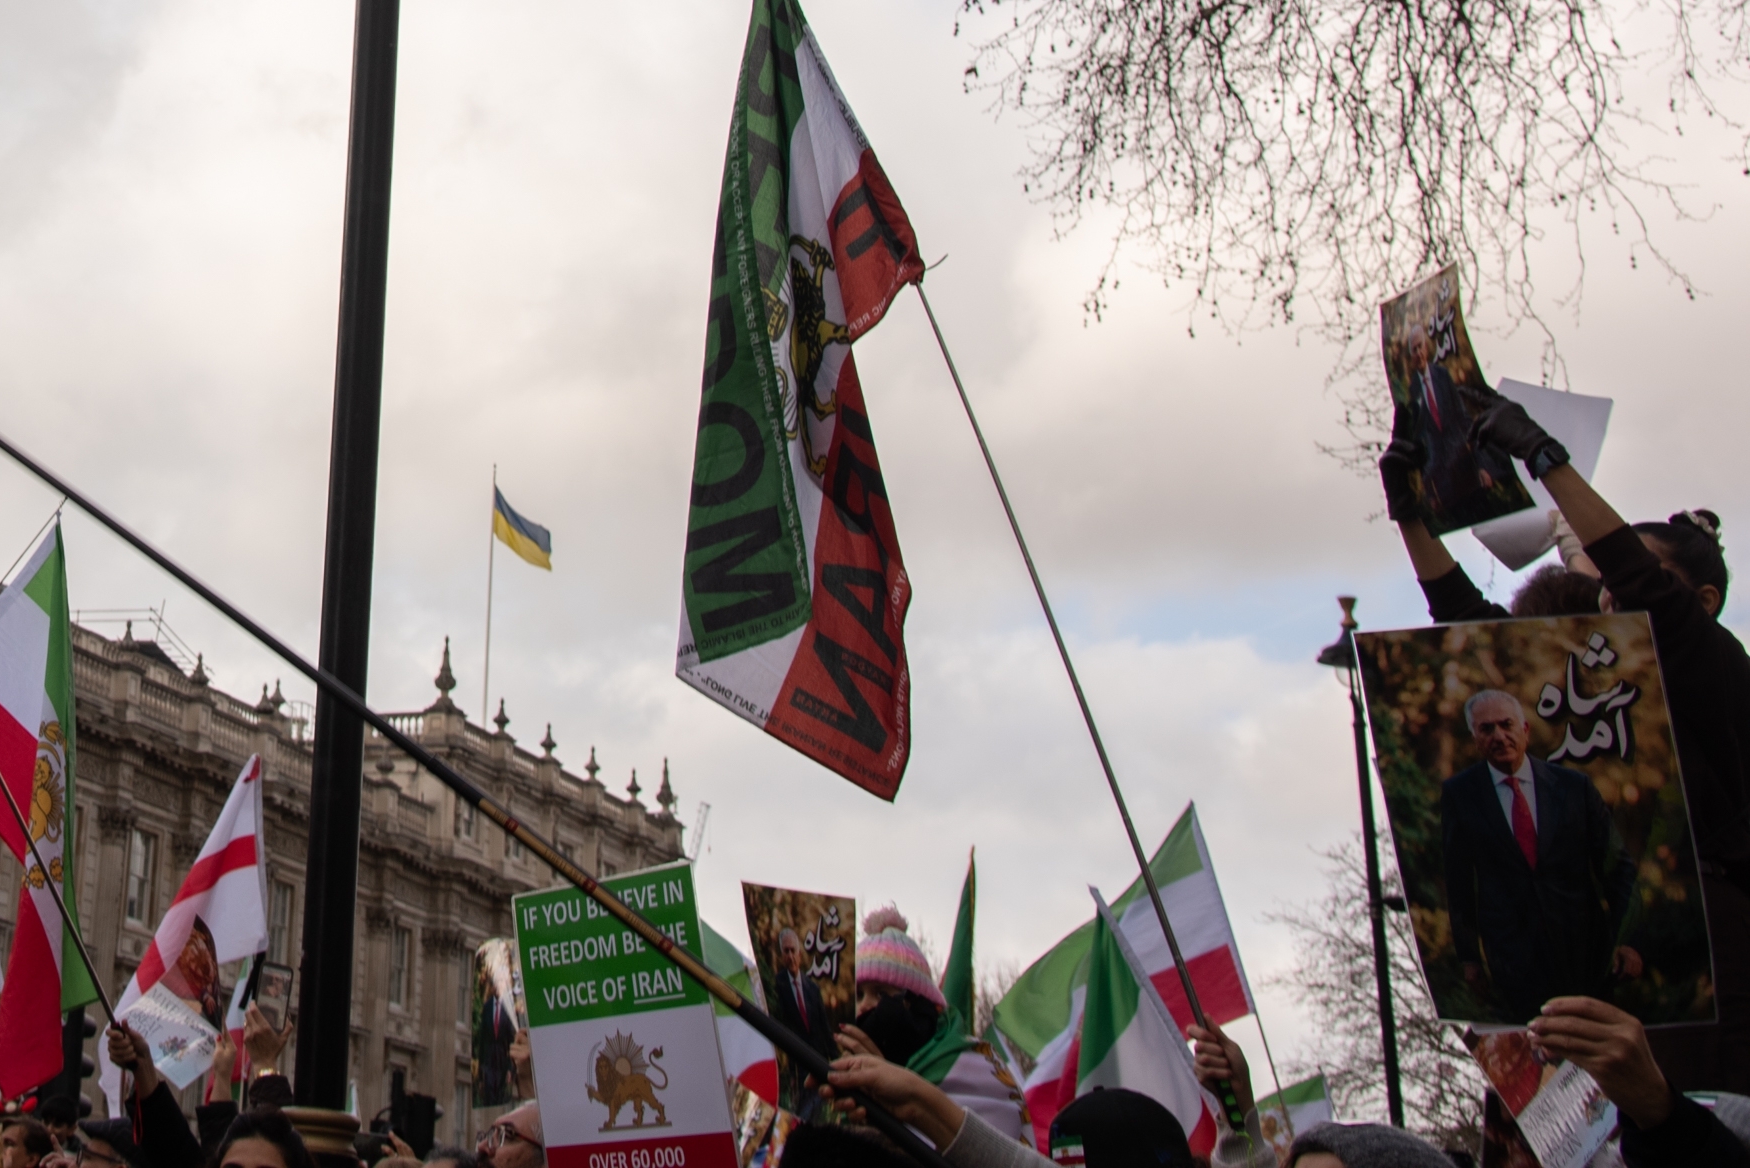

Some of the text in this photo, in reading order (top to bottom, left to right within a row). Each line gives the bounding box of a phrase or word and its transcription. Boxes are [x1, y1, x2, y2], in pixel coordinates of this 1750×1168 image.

[1428, 278, 1453, 338] شاه
[737, 254, 757, 331] FOREIGNERS
[749, 332, 768, 377] RULING
[769, 418, 785, 453] FROM
[700, 628, 746, 650] ISLAMIC
[748, 621, 768, 634] THE
[770, 616, 784, 627] TO
[1536, 631, 1624, 719] شاه
[1546, 686, 1637, 763] آمد
[523, 906, 538, 931] IF
[541, 898, 581, 927] YOU
[662, 878, 684, 905] IN
[529, 933, 617, 971] FREEDOM
[622, 930, 646, 955] BE
[656, 921, 688, 947] HE
[804, 905, 842, 954] شاه
[543, 980, 598, 1011] VOICE
[602, 975, 627, 1002] OF
[631, 966, 684, 999] IRAN
[589, 1145, 686, 1168] OVER 60,000
